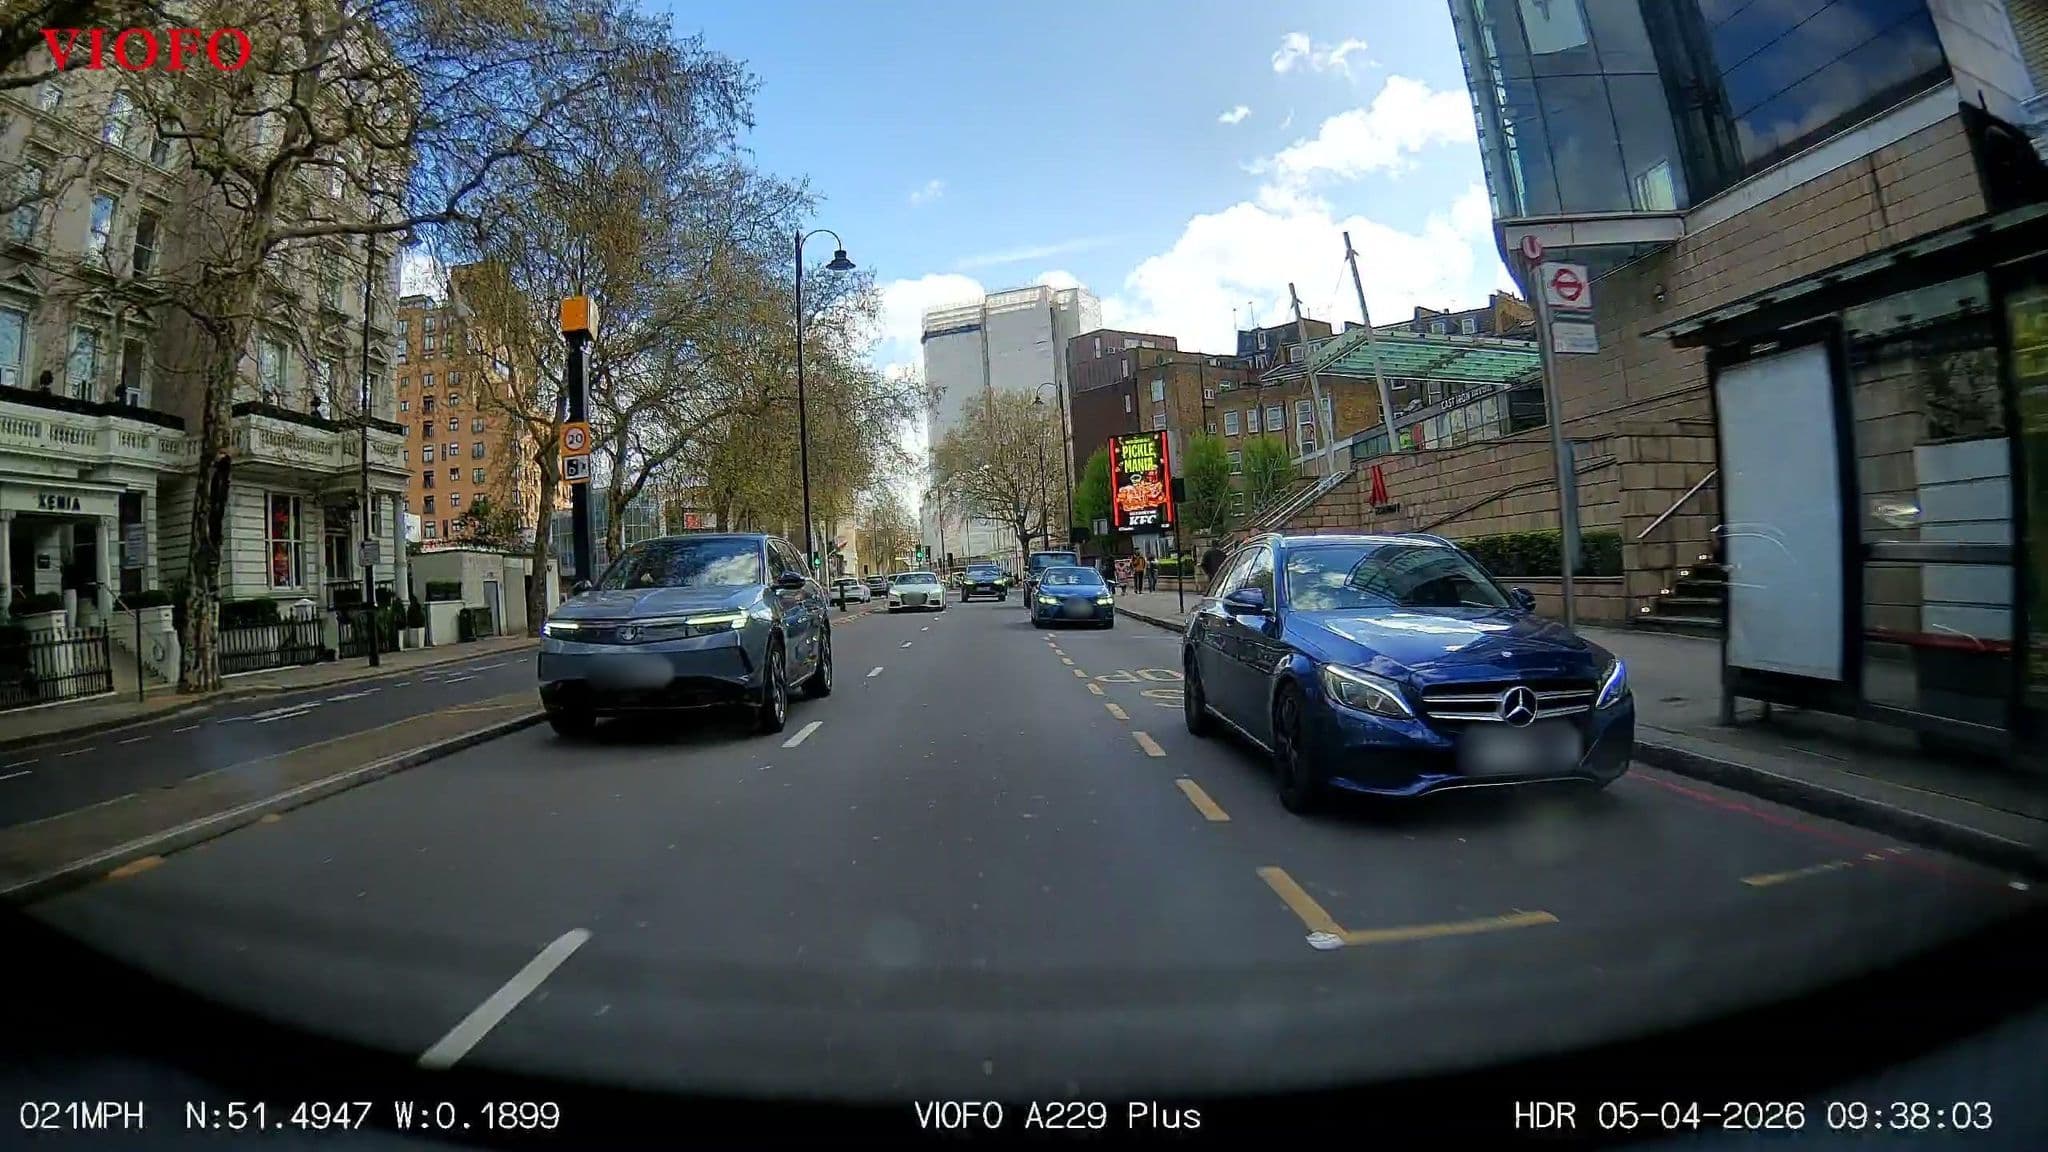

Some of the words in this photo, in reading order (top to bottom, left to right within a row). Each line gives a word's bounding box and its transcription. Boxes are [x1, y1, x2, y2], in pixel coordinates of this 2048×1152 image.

[568, 433, 583, 445] 20
[1122, 443, 1156, 458] PICKLE
[1125, 457, 1154, 473] MANIA
[1129, 514, 1156, 526] KFC
